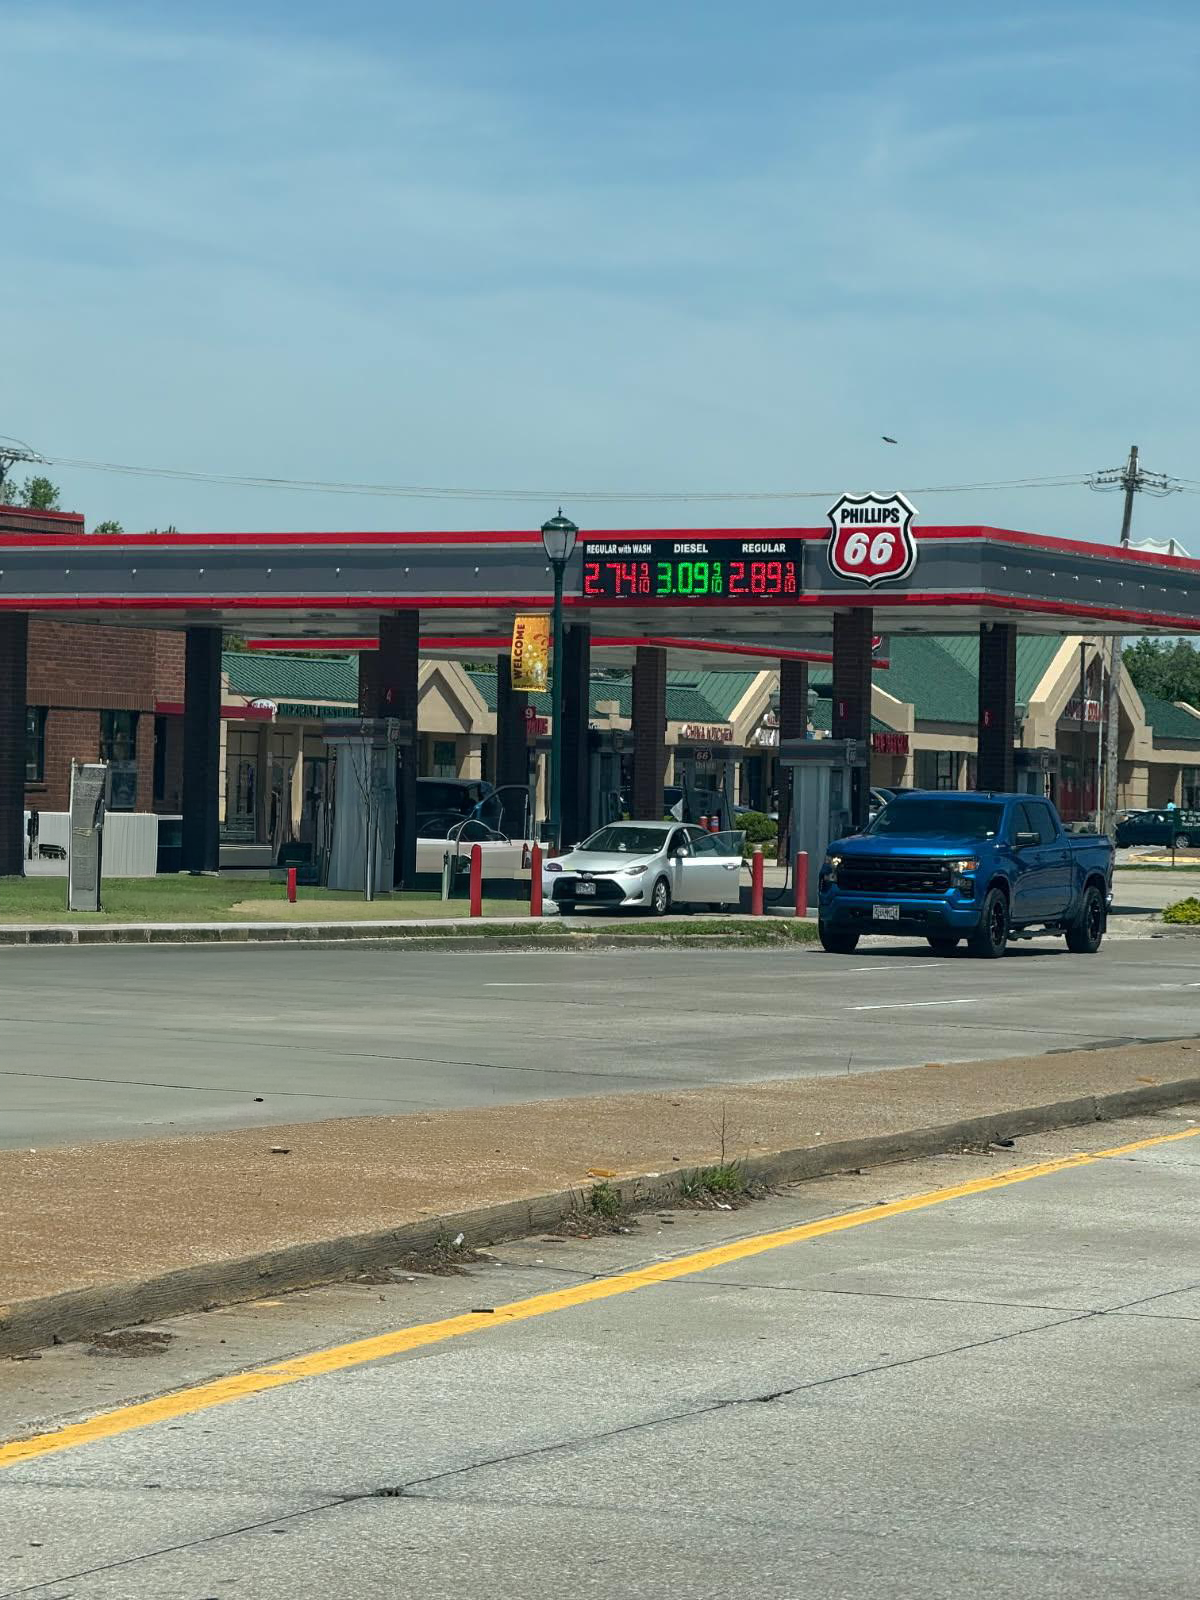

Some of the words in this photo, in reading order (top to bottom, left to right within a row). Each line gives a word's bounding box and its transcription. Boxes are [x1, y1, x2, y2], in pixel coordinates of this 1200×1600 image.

[841, 507, 900, 524] PHILLIPS
[586, 544, 617, 554] REGULAR
[617, 545, 631, 554] with
[632, 544, 652, 554] WASH
[673, 543, 709, 553] DIESEL
[742, 543, 786, 553] REGULAR
[843, 532, 896, 566] 66
[584, 562, 637, 593] 2.74
[656, 562, 709, 593] 3.09
[729, 562, 782, 593] 2.89
[513, 624, 526, 679] WELCOME
[524, 707, 532, 719] 9
[686, 724, 706, 739] CHINA
[706, 726, 733, 741] KITCHEN
